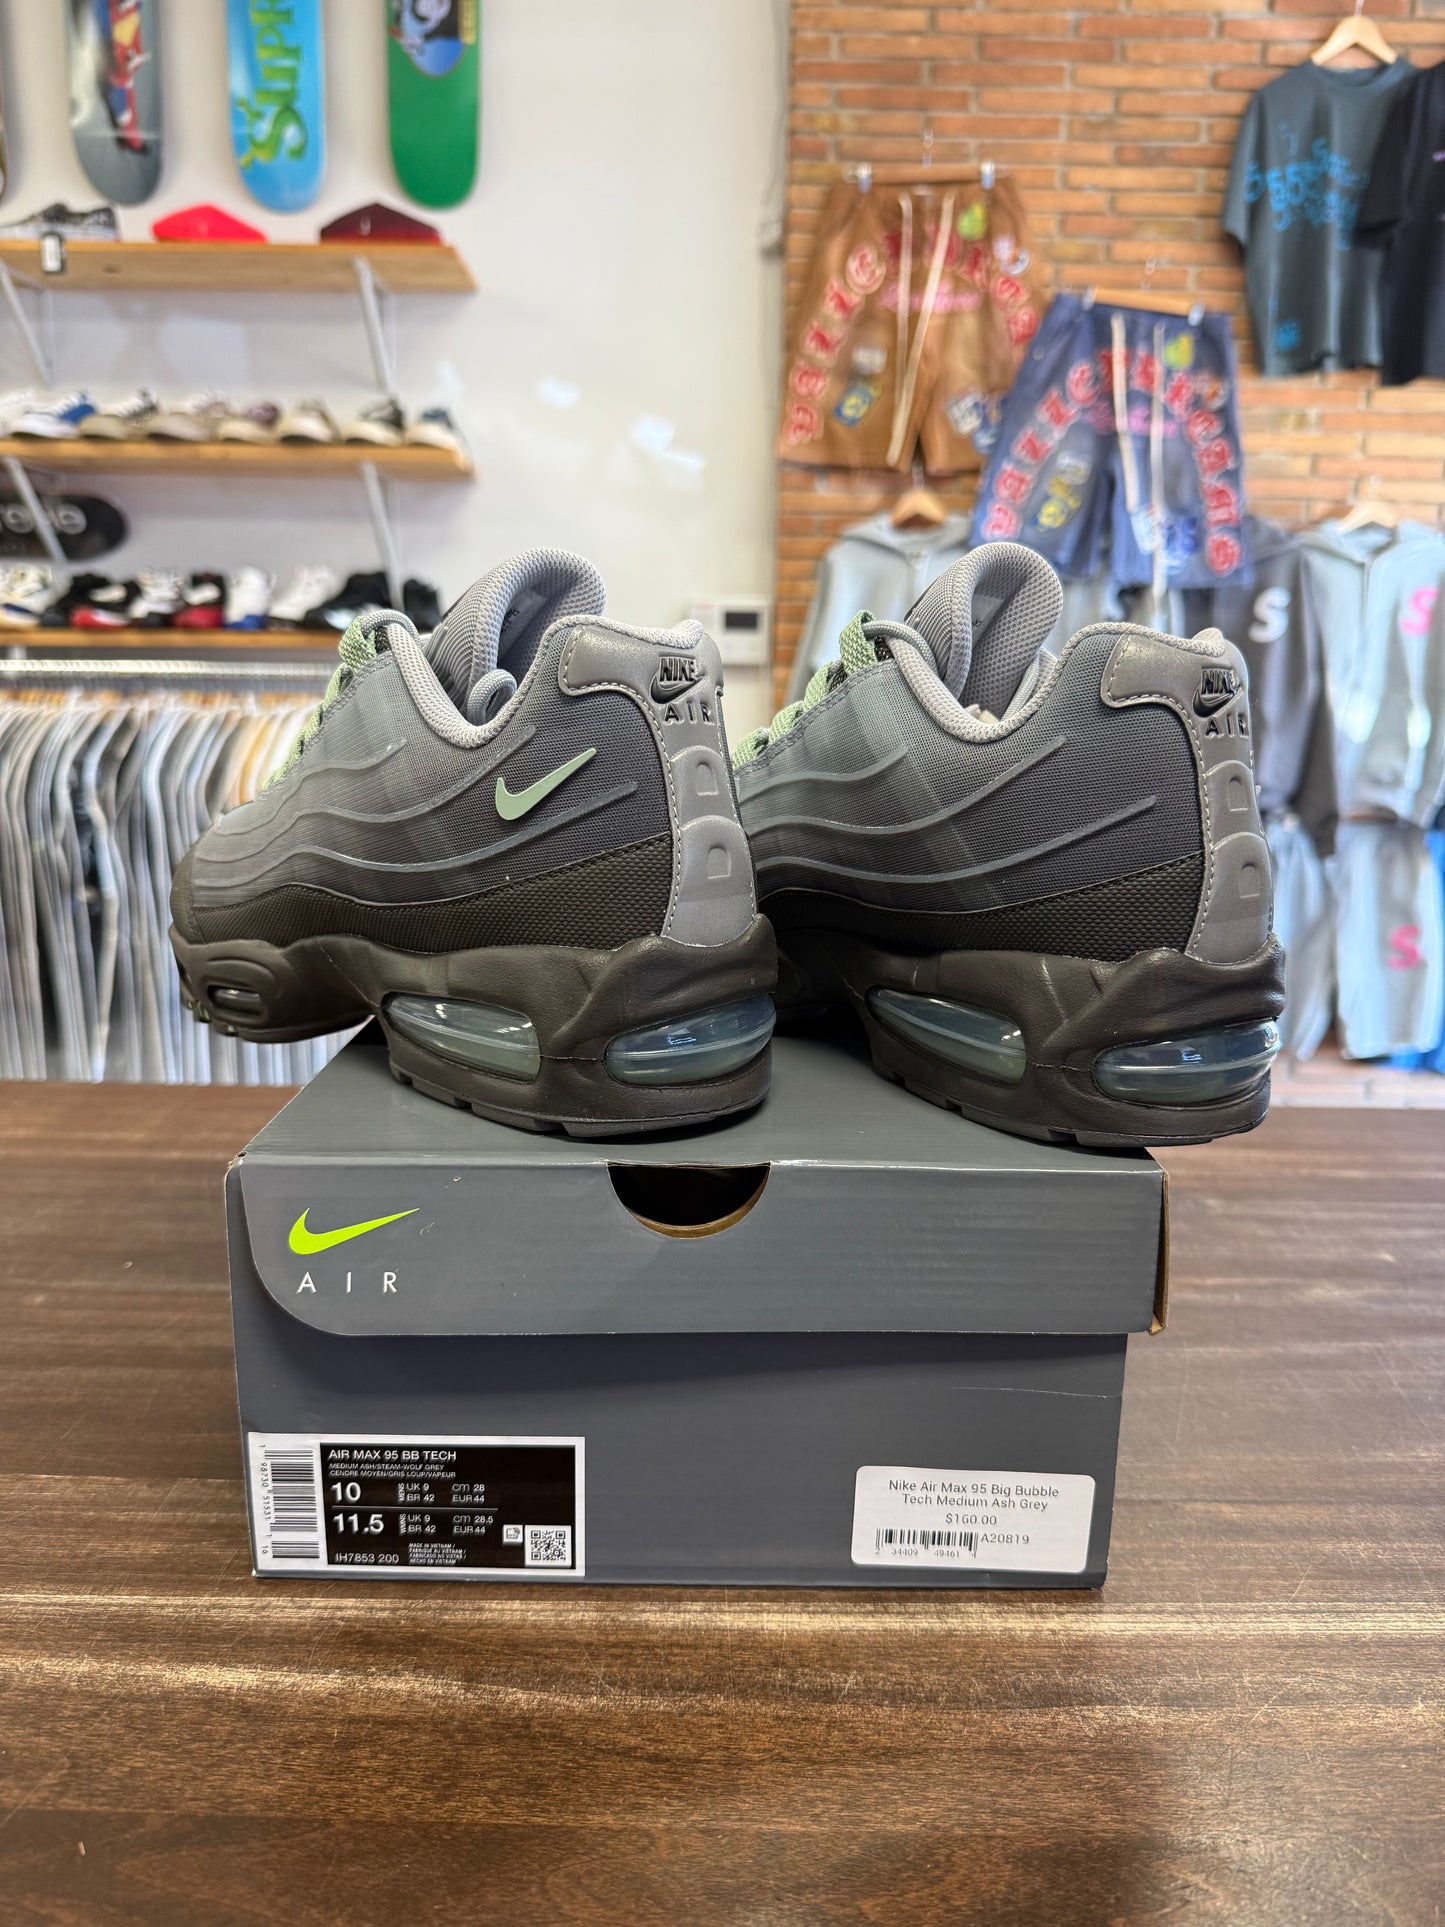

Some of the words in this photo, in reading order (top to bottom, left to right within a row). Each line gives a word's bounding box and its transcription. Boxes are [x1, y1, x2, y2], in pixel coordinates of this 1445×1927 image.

[1249, 587, 1290, 643] S
[1400, 587, 1438, 635] S
[659, 657, 697, 682] NIKE
[664, 700, 713, 722] AIR
[1388, 925, 1420, 970] S
[328, 1449, 349, 1459] AIR
[353, 1450, 381, 1459] MAX
[384, 1450, 398, 1459] 95
[402, 1451, 420, 1460] BB
[423, 1451, 457, 1460] TECH
[332, 1482, 361, 1501] 10
[406, 1483, 420, 1491] UK
[423, 1483, 430, 1491] 9
[473, 1484, 485, 1492] 28
[889, 1479, 916, 1491] Nike
[920, 1481, 936, 1492] Air
[941, 1482, 967, 1493] Max
[971, 1483, 987, 1494] 95
[991, 1484, 1011, 1497] Big
[1015, 1485, 1059, 1497] Bubble
[407, 1493, 420, 1501] BR
[452, 1494, 472, 1502] EUR
[473, 1495, 485, 1503] 44
[902, 1493, 932, 1505] Tech
[936, 1495, 988, 1507] Medium
[991, 1498, 1016, 1508] Ash
[1020, 1498, 1048, 1512] Grey
[333, 1513, 384, 1533] 11.5
[408, 1514, 421, 1522] UK
[424, 1514, 431, 1522] 9
[474, 1515, 494, 1524] 28.5
[425, 1525, 436, 1533] 42
[474, 1526, 486, 1534] 44
[980, 1533, 1030, 1545] A20819
[336, 1553, 375, 1562] IH7853
[378, 1554, 399, 1563] 200
